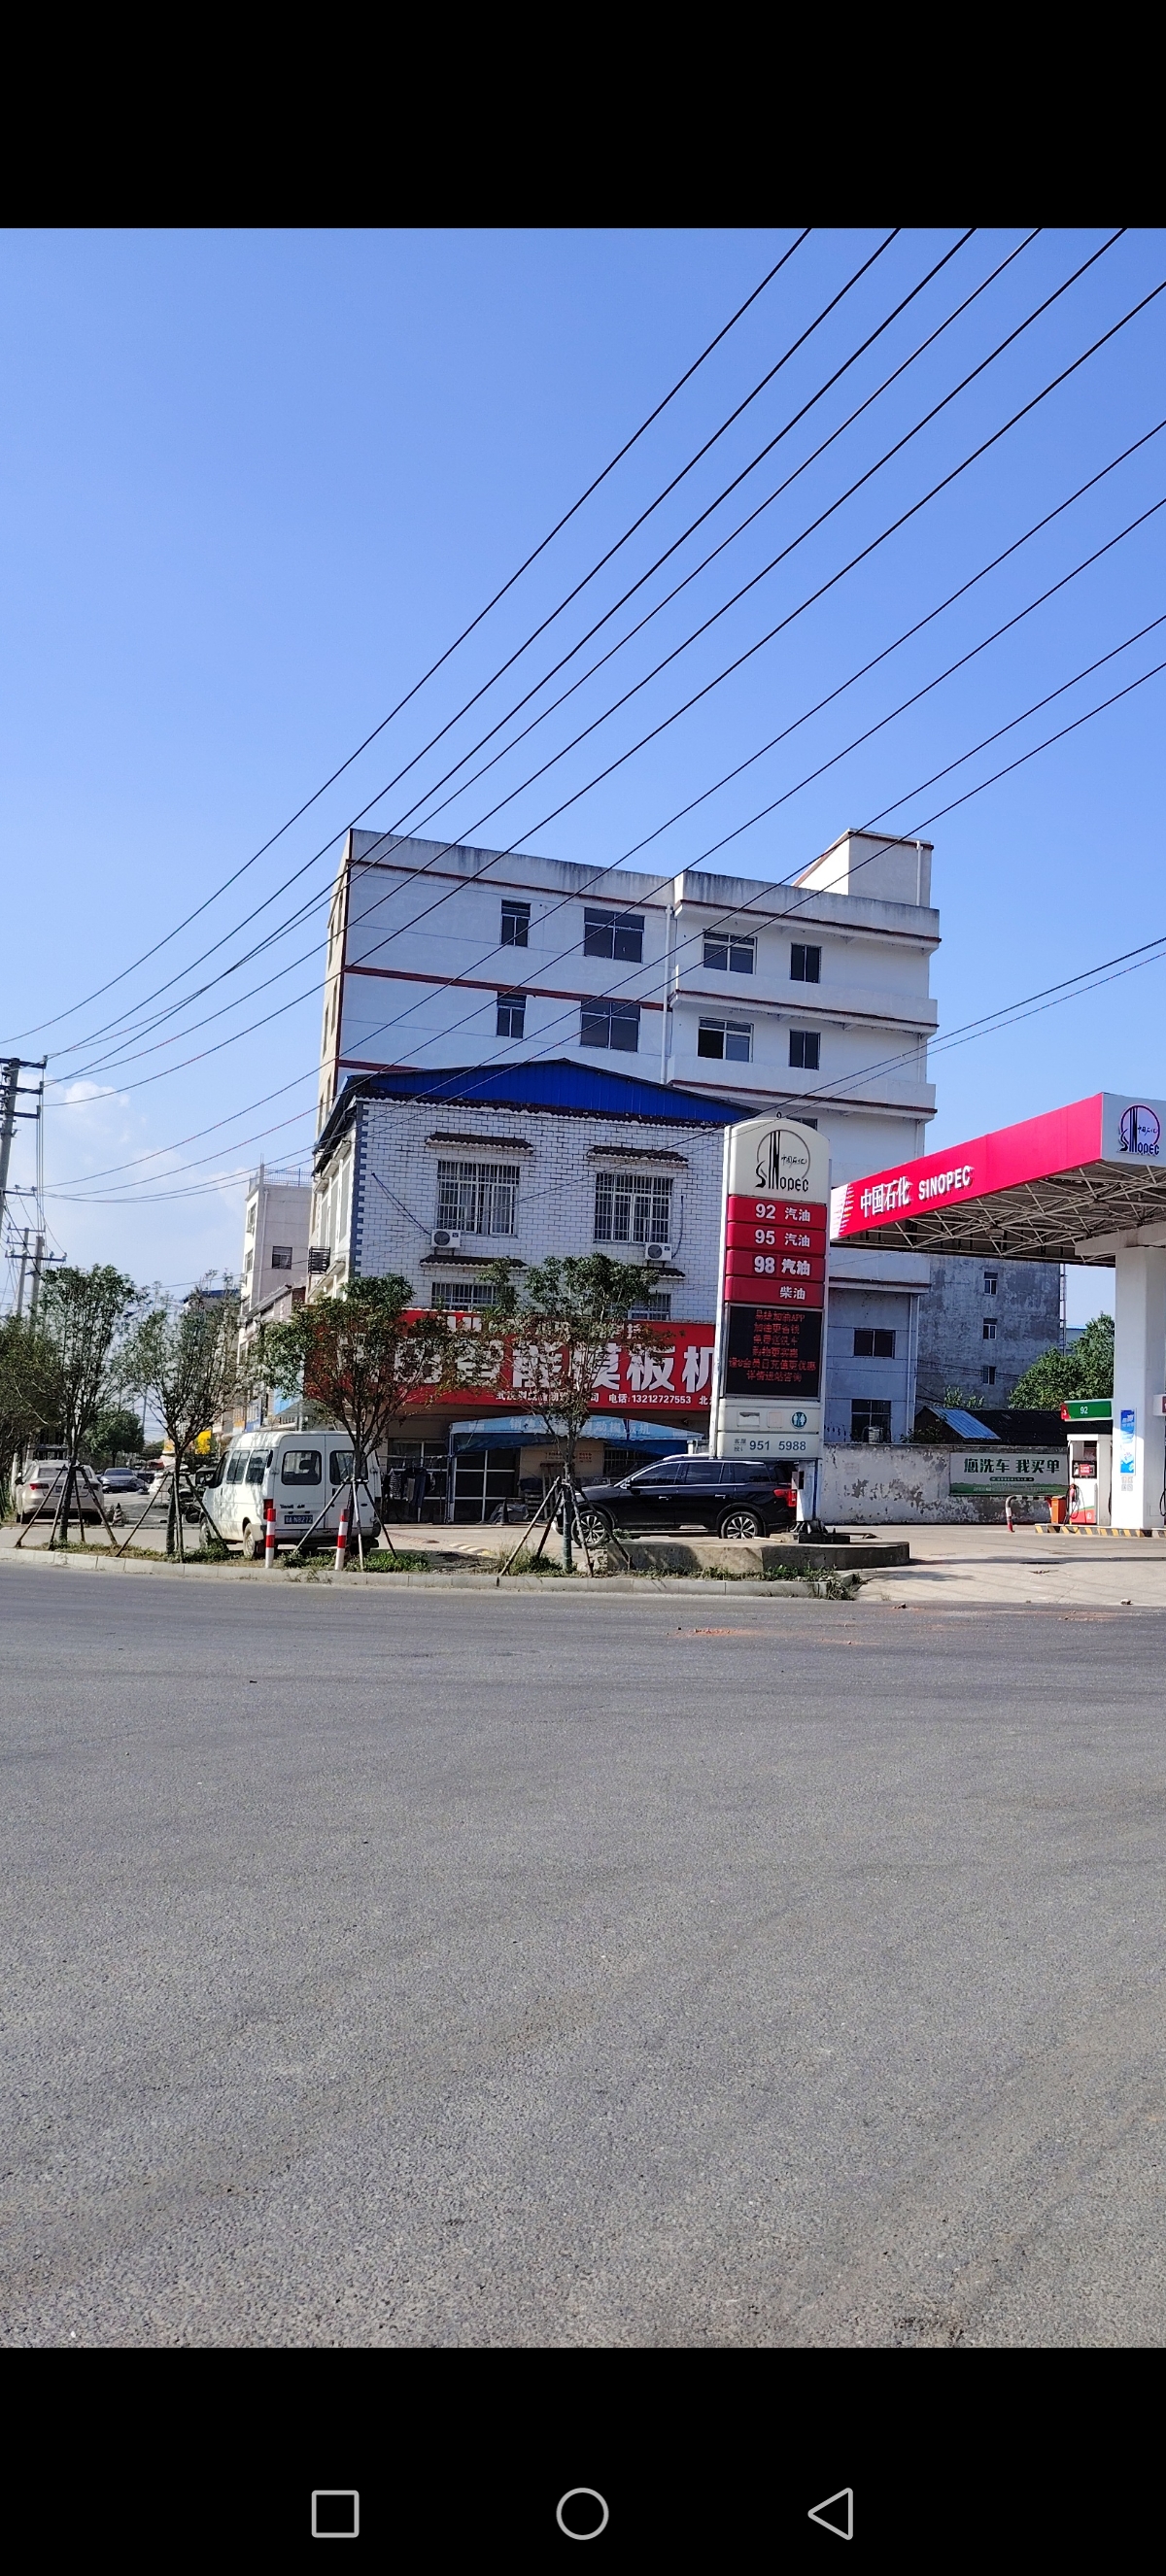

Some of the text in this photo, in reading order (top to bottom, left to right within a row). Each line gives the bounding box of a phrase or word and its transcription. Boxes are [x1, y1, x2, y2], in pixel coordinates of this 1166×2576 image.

[860, 1166, 975, 1218] 中国石化 SINOPEC
[756, 1203, 811, 1223] 92 汽油
[755, 1229, 810, 1248] 95 汽油
[754, 1256, 810, 1276] 98 汽油
[779, 1286, 806, 1301] 柴油
[749, 1441, 770, 1451] 951
[778, 1441, 806, 1451] 5988
[964, 1458, 1060, 1474] 您洗车 我买单
